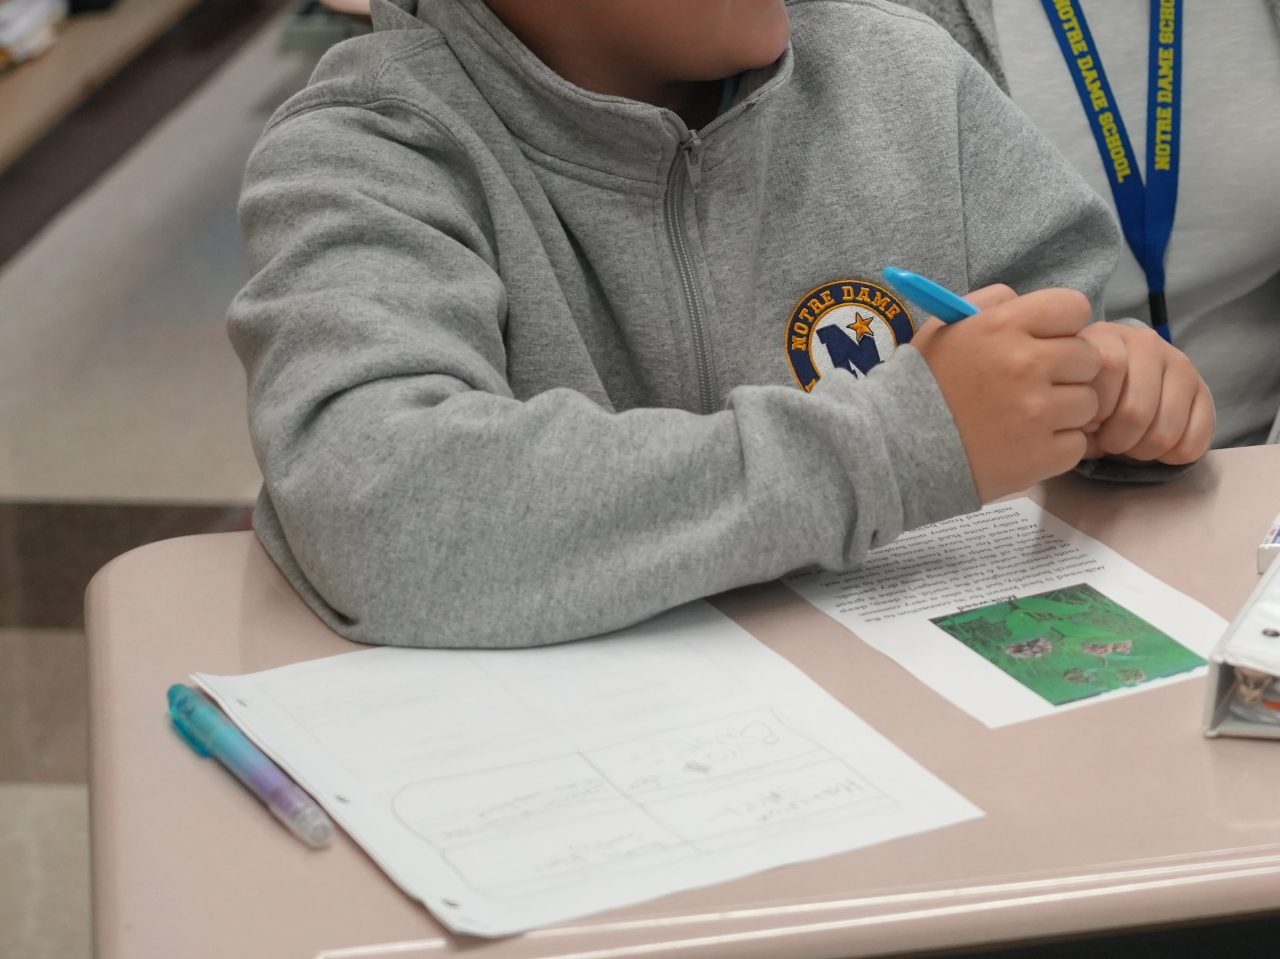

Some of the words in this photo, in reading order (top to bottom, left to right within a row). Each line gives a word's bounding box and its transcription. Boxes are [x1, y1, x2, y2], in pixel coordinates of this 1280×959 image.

[1158, 48, 1174, 103] DAME
[1077, 55, 1109, 112] DAME
[1099, 111, 1132, 183] SCHOOL
[1155, 107, 1172, 171] NOTRE
[792, 290, 835, 351] NOTRE
[842, 286, 900, 320] DAME
[816, 323, 885, 379] N
[956, 594, 1019, 612] Milkweed
